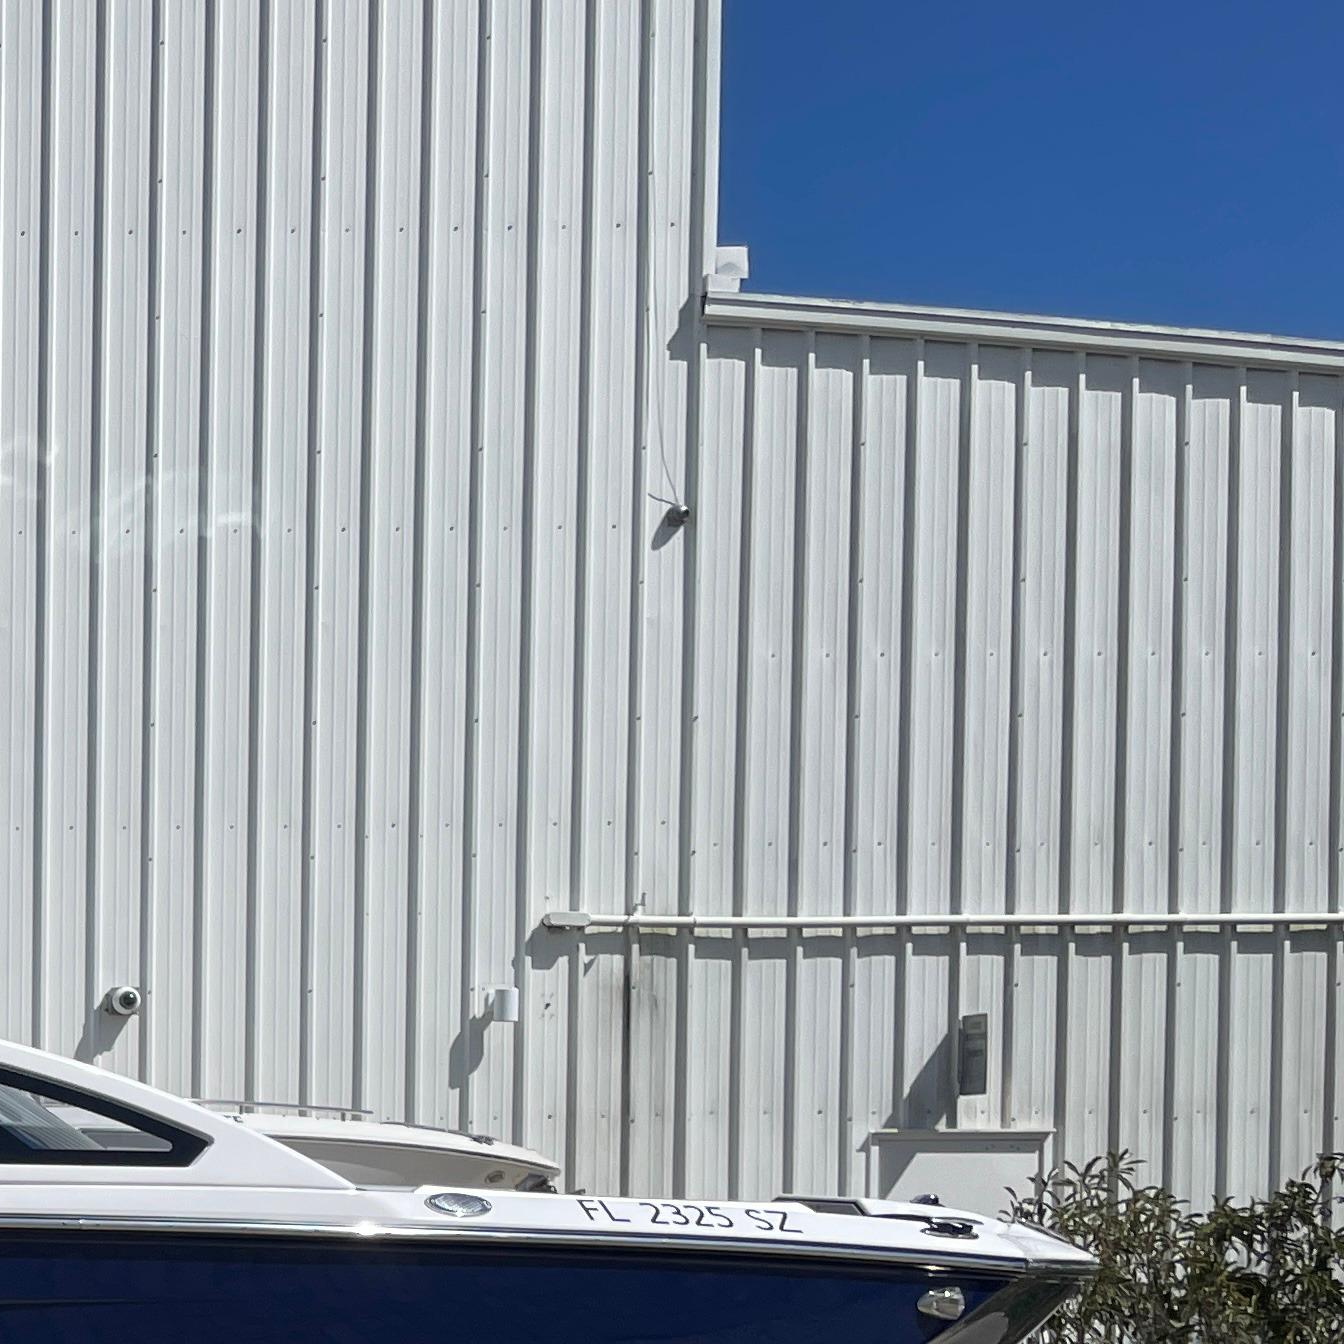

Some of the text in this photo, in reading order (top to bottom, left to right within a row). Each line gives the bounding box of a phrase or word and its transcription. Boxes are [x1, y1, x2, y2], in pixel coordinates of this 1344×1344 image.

[575, 1198, 804, 1233] FL 2325 SZ
